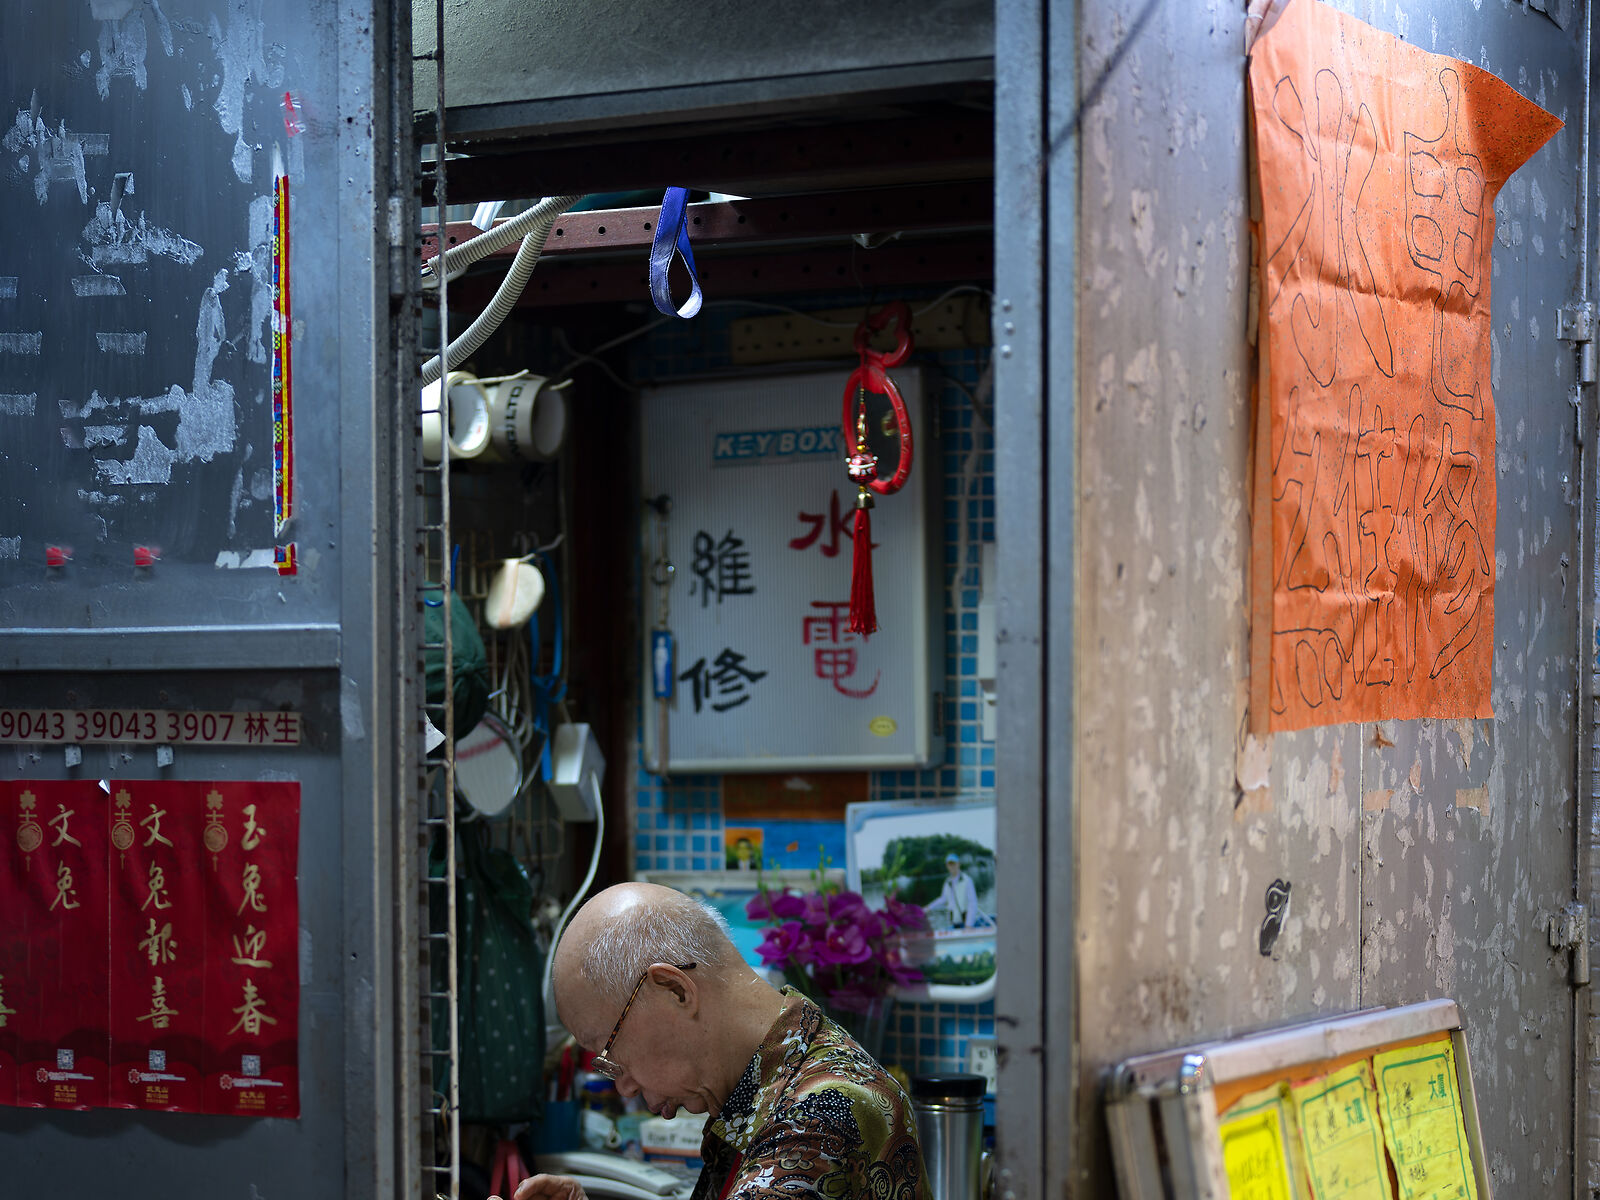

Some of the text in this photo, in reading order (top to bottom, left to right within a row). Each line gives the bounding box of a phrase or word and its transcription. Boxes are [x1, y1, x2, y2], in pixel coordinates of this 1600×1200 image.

[716, 429, 837, 458] KEY BOX
[678, 529, 767, 715] 維修
[788, 489, 881, 699] 水電
[243, 712, 299, 744] 林生
[226, 802, 279, 1037] 玉兔迎春
